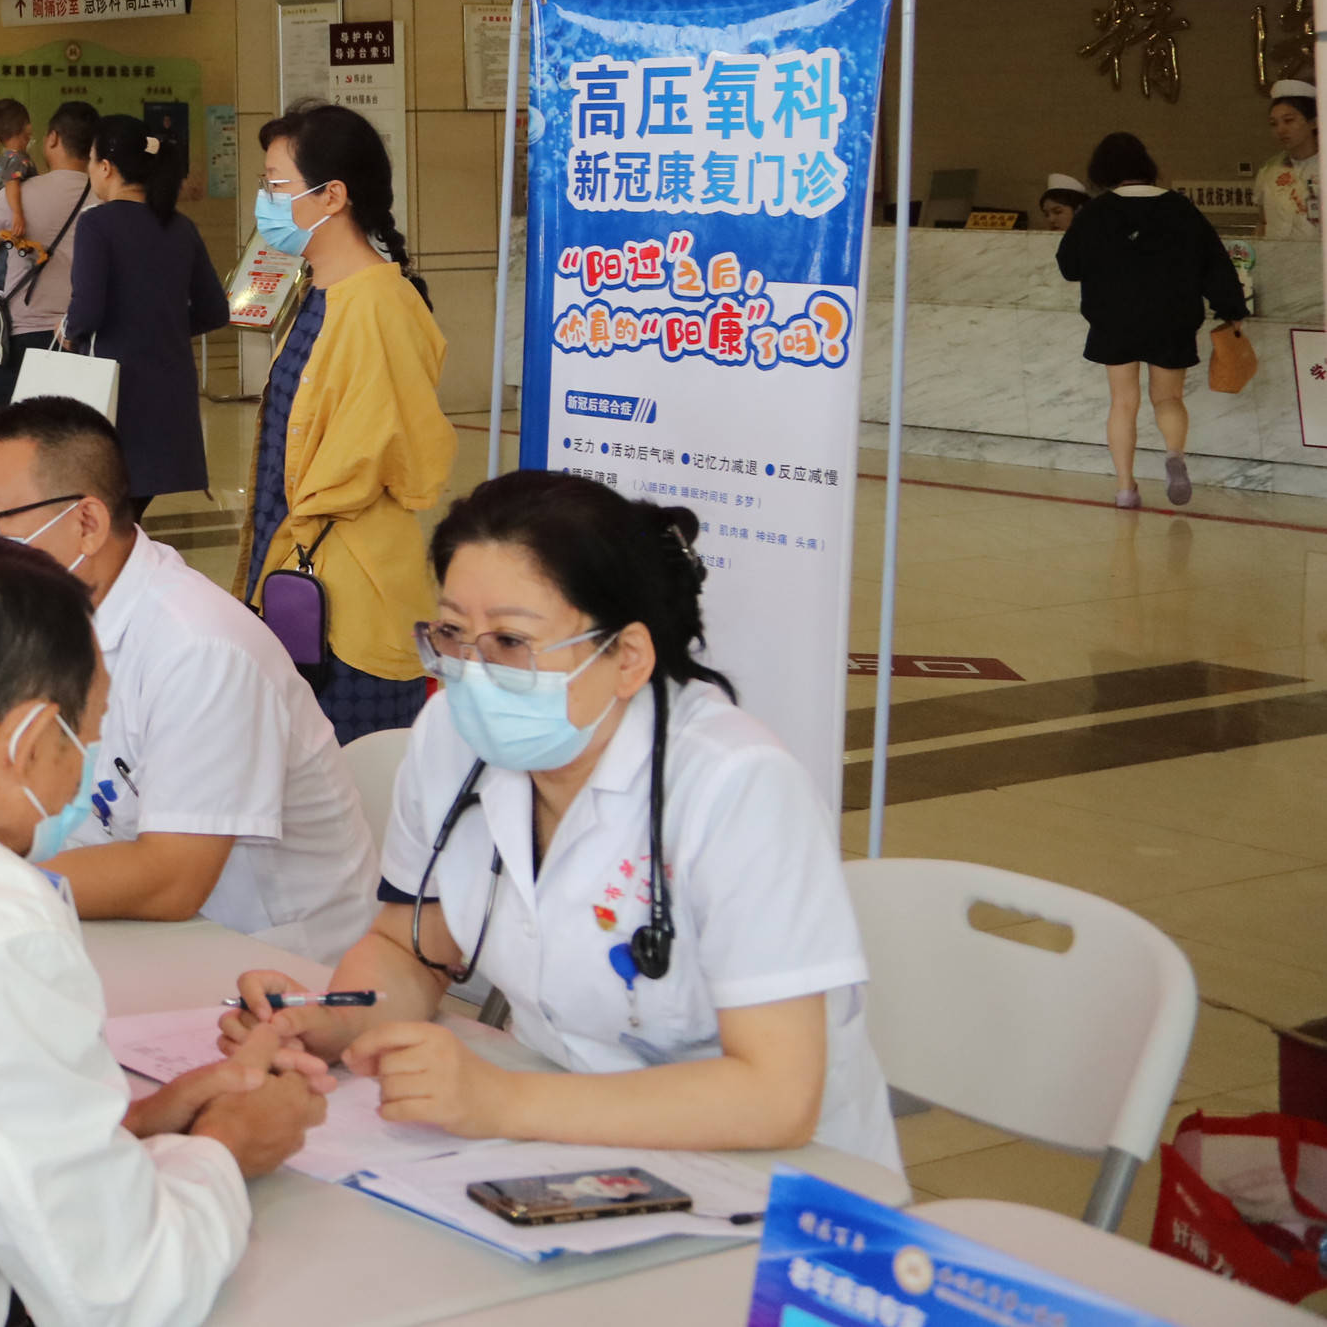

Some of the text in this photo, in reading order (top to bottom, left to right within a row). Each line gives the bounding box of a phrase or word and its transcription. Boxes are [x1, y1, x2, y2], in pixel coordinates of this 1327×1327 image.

[335, 46, 391, 59] 导诊台索引
[341, 31, 385, 43] 导护中心
[576, 58, 838, 140] 高压氧科
[573, 151, 840, 208] 新冠康复门诊
[1178, 187, 1260, 208] 人及优抚对象优
[562, 231, 764, 294] “阳过”之后，
[567, 395, 633, 416] 新冠后综合症
[573, 438, 839, 487] 乏力 活动后气喘 记忆力减退 反应减慢
